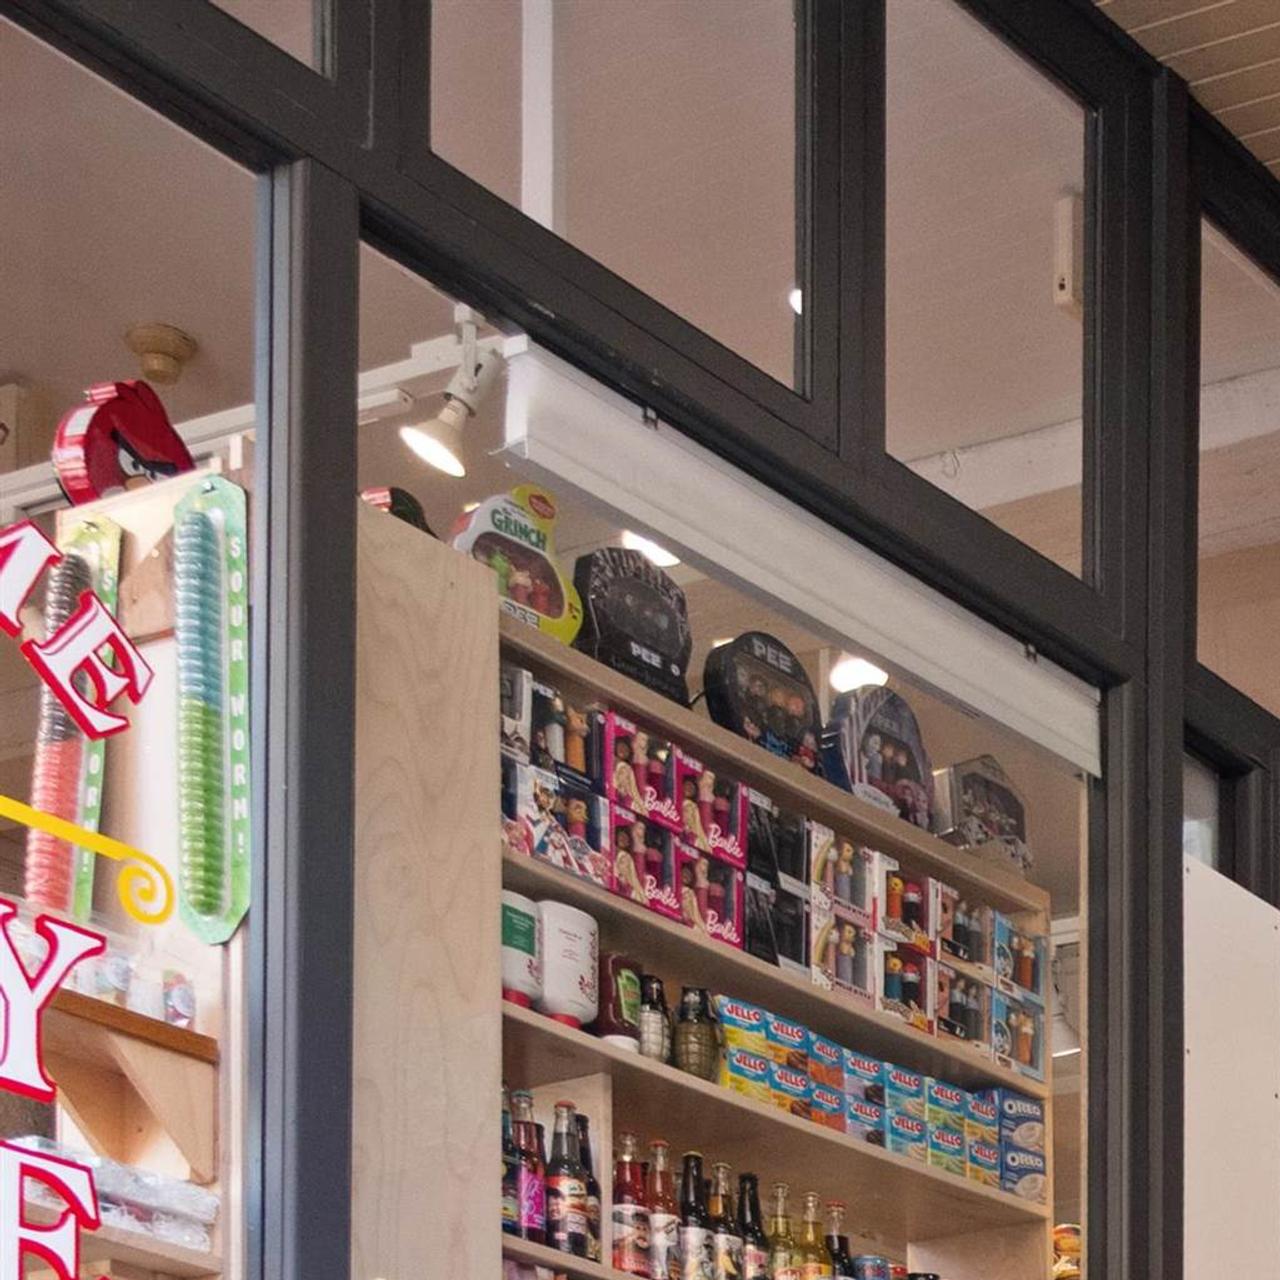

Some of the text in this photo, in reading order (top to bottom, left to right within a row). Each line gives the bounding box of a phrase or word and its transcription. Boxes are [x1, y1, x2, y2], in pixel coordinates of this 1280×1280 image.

[490, 508, 547, 551] GRINCH
[229, 536, 244, 661] SOUR
[630, 641, 663, 669] PEZ
[752, 637, 793, 673] PEZ
[643, 786, 680, 823] Barbie
[707, 823, 744, 859] Barbie
[643, 874, 680, 910] Barbie
[705, 909, 740, 944] Barbie
[1003, 1099, 1042, 1117] OREO
[1005, 1151, 1044, 1169] OREO
